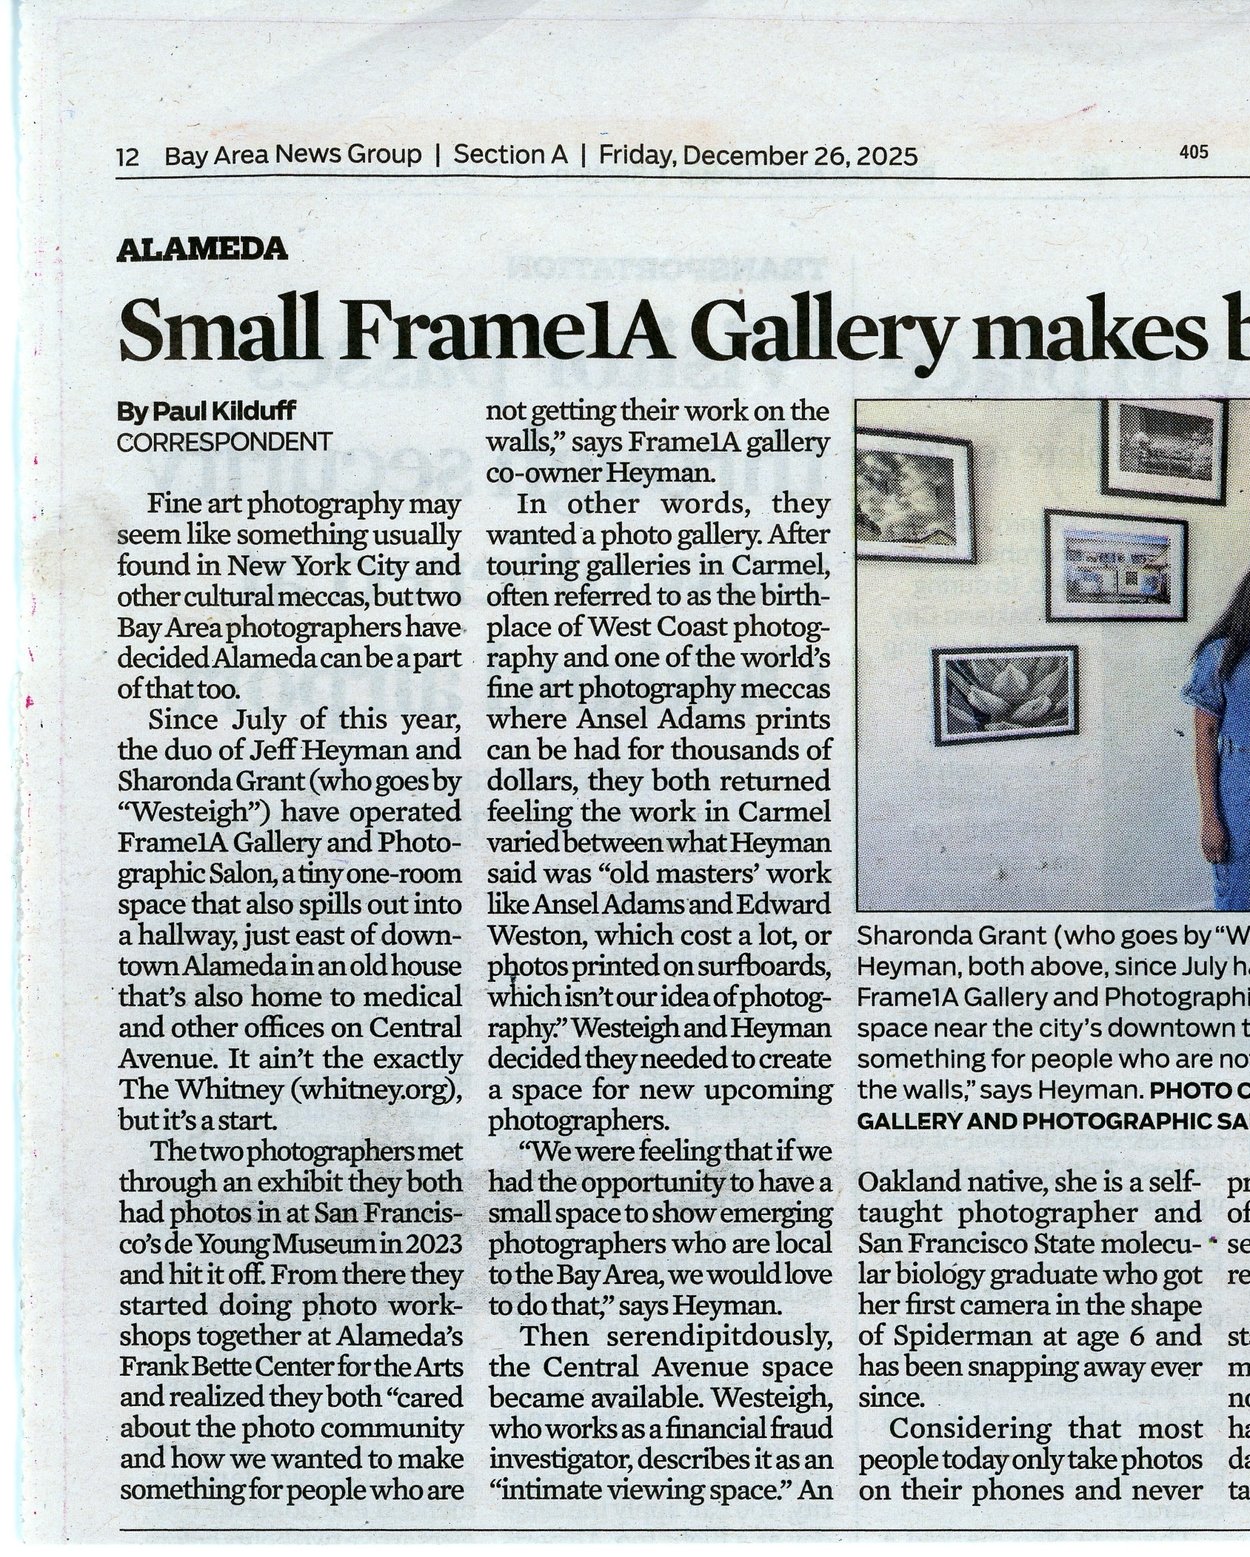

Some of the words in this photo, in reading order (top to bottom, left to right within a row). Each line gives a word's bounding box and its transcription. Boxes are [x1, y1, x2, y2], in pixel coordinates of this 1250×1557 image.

[116, 147, 140, 167] 12
[165, 146, 209, 170] Bay
[213, 145, 270, 165] Area
[276, 143, 342, 164] News
[347, 143, 422, 168] Group
[453, 143, 545, 165] Section
[550, 144, 569, 164] A
[600, 143, 677, 169] Friday,
[684, 144, 809, 166] December
[814, 146, 851, 169] 26,
[856, 146, 919, 167] 2025
[1179, 144, 1209, 160] 405
[116, 235, 289, 263] ALAMEDA
[119, 289, 325, 362] Small
[690, 290, 961, 379] Gallery
[972, 291, 1209, 362] makes
[117, 400, 150, 426] By
[153, 400, 207, 422] Paul
[212, 399, 298, 421] Kilduff
[116, 431, 334, 453] CORRESPONDENT
[571, 436, 623, 458] says
[746, 428, 832, 459] gallery
[116, 551, 191, 577] found
[196, 552, 222, 576] in
[227, 554, 287, 577] New
[290, 552, 352, 577] York
[357, 552, 410, 582] City
[415, 551, 462, 576] and
[485, 705, 567, 730] where
[575, 705, 649, 730] Ansel
[656, 705, 746, 730] Adams
[755, 706, 831, 736] prints
[280, 798, 340, 823] have
[349, 797, 463, 829] operated
[487, 859, 538, 884] said
[542, 867, 592, 884] was
[765, 859, 833, 884] work
[964, 986, 1049, 1011] Gallery
[1053, 985, 1099, 1007] and
[117, 1047, 219, 1070] Avenue.
[228, 1047, 251, 1069] It
[322, 1044, 364, 1069] the
[373, 1045, 464, 1075] exactly
[118, 1075, 170, 1100] The
[174, 1075, 286, 1106] Whitney
[290, 1075, 463, 1106] (whitney.org),
[857, 1078, 898, 1100] the
[979, 1083, 1033, 1104] says
[1038, 1079, 1144, 1104] Heyman.
[1150, 1081, 1233, 1100] PHOTO
[857, 1112, 964, 1131] GALLERY
[966, 1112, 1018, 1130] AND
[1022, 1112, 1213, 1130] PHOTOGRAPHIC
[858, 1232, 904, 1254] San
[907, 1230, 1029, 1255] Francisco
[1034, 1232, 1096, 1255] State
[1100, 1230, 1202, 1255] molecu-
[119, 1322, 192, 1353] shops
[196, 1322, 302, 1352] together
[307, 1326, 332, 1346] at
[519, 1322, 590, 1347] Then
[606, 1321, 833, 1353] serendipitdously,
[858, 1321, 887, 1346] of
[893, 1321, 1034, 1352] Spiderman
[1043, 1326, 1068, 1347] at
[1076, 1330, 1120, 1353] age
[1129, 1325, 1145, 1347] 6
[1155, 1322, 1203, 1347] and
[487, 1384, 585, 1409] became
[591, 1384, 704, 1409] available.
[709, 1383, 834, 1414] Westeigh,
[889, 1414, 1053, 1446] Considering
[1067, 1415, 1122, 1440] that
[1138, 1419, 1204, 1440] most
[606, 1476, 707, 1506] viewing
[796, 1479, 834, 1501] An
